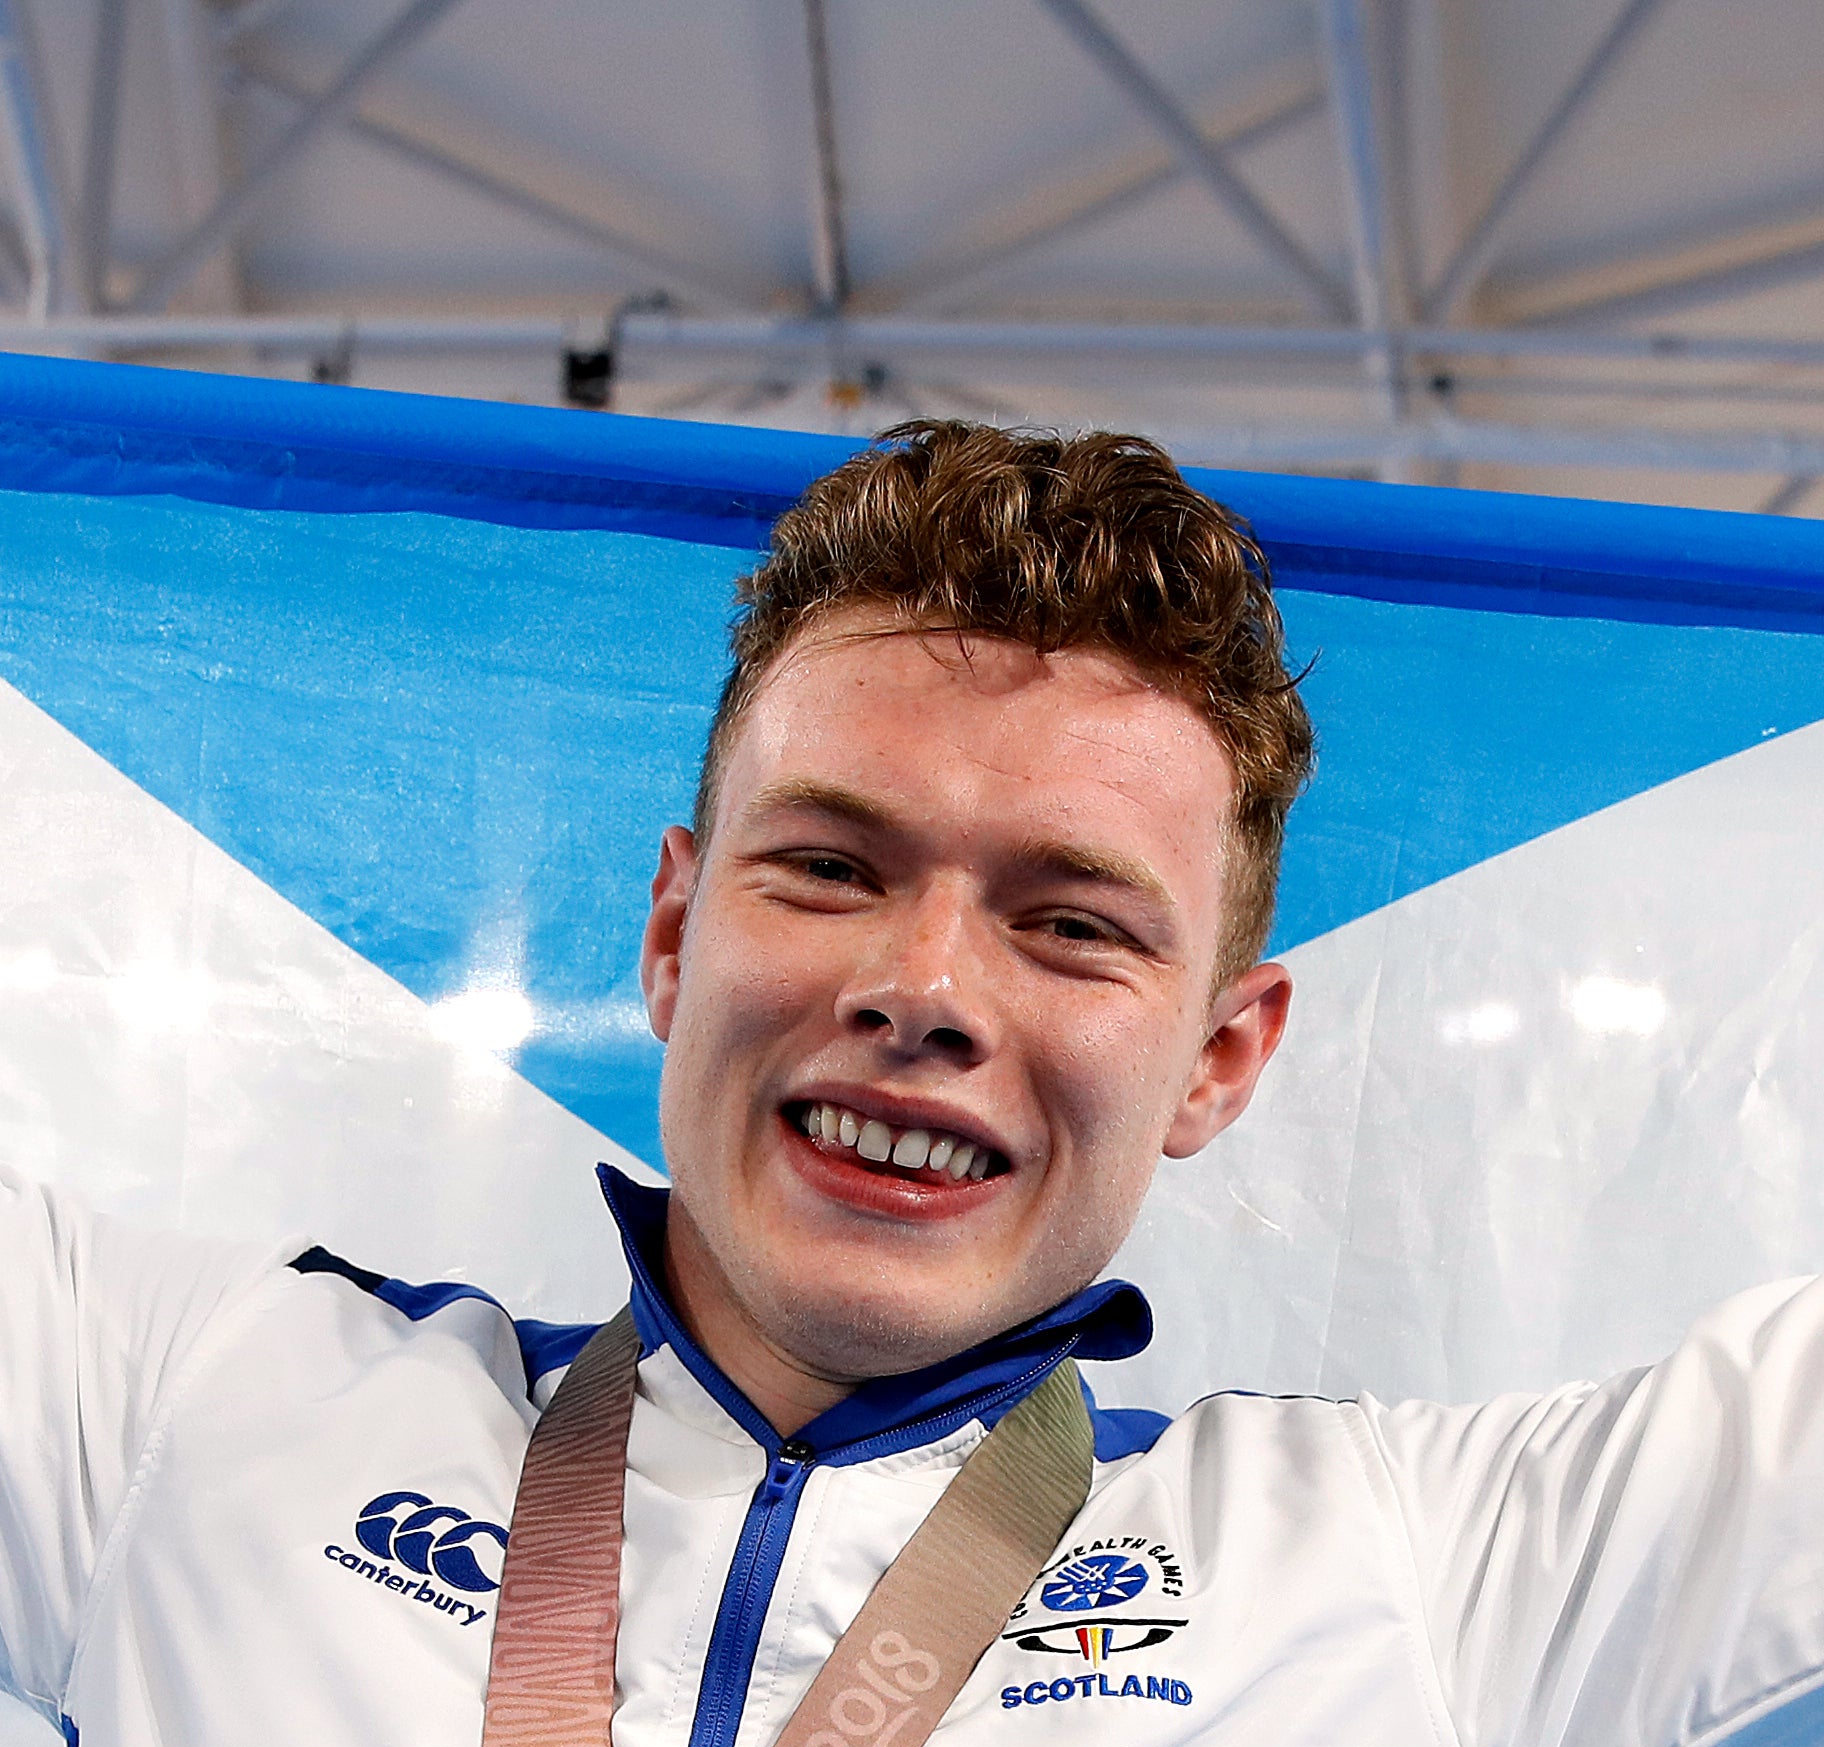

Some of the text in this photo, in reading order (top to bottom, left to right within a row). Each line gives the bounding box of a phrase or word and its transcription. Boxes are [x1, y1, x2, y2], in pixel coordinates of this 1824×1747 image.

[324, 1545, 487, 1626] canterbury
[1147, 1545, 1184, 1597] GAMES
[1001, 1673, 1193, 1708] SCOTLAND
